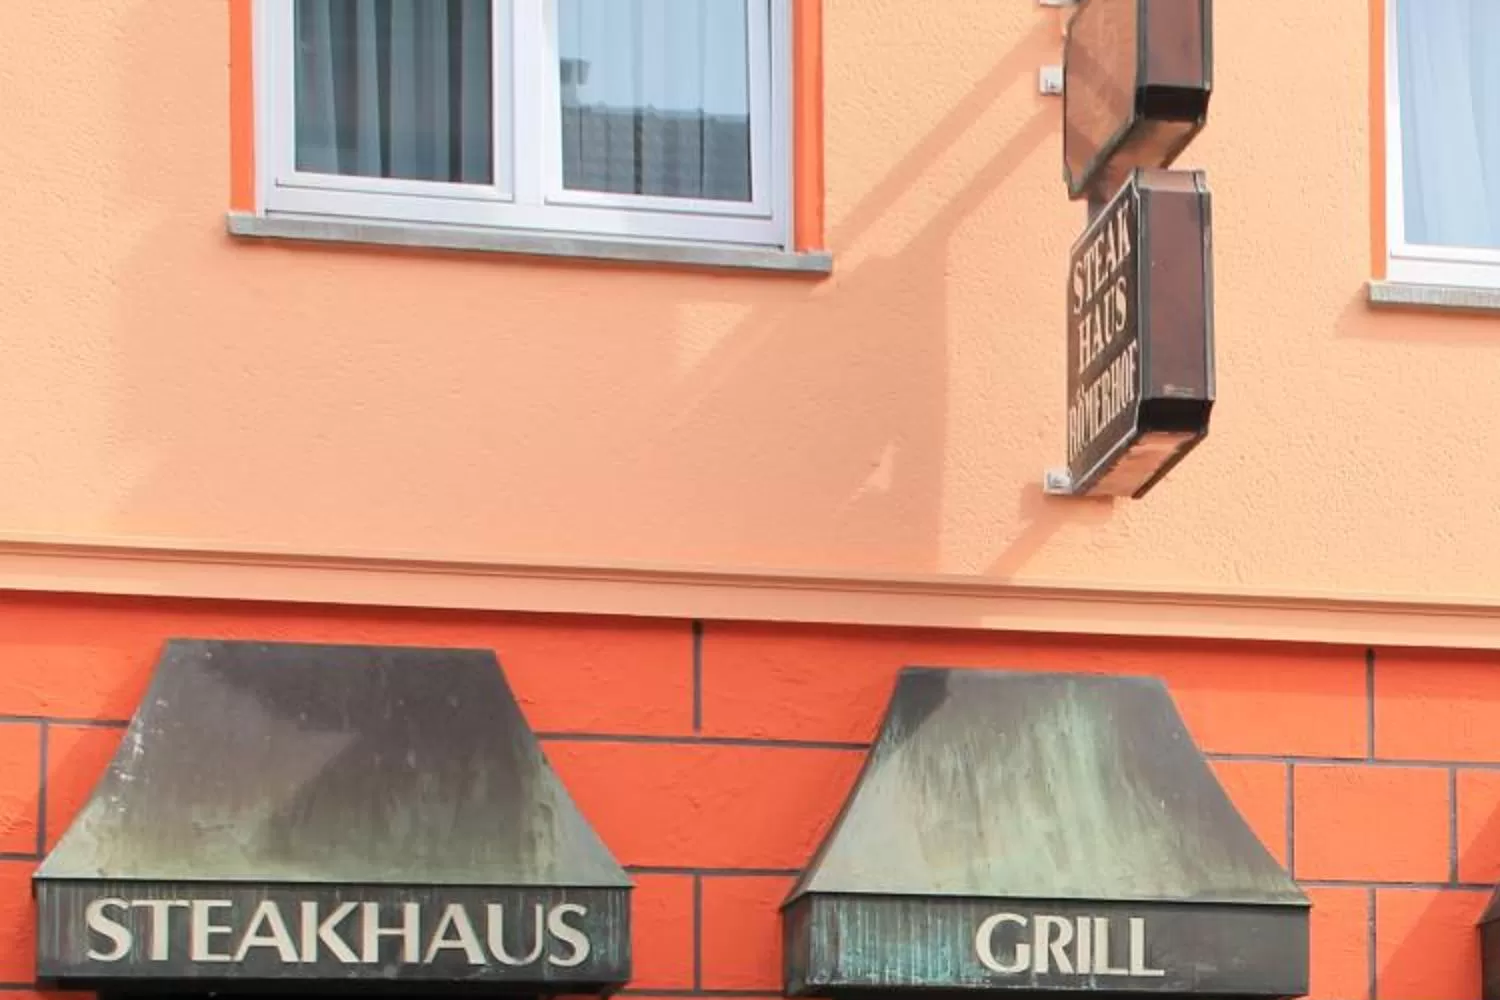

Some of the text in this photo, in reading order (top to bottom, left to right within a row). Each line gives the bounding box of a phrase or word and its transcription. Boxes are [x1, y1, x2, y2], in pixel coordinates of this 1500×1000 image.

[1073, 200, 1131, 315] STEAK
[1079, 275, 1128, 374] HAUS
[84, 896, 591, 968] STEAKHAUS
[974, 912, 1165, 977] GRILL
